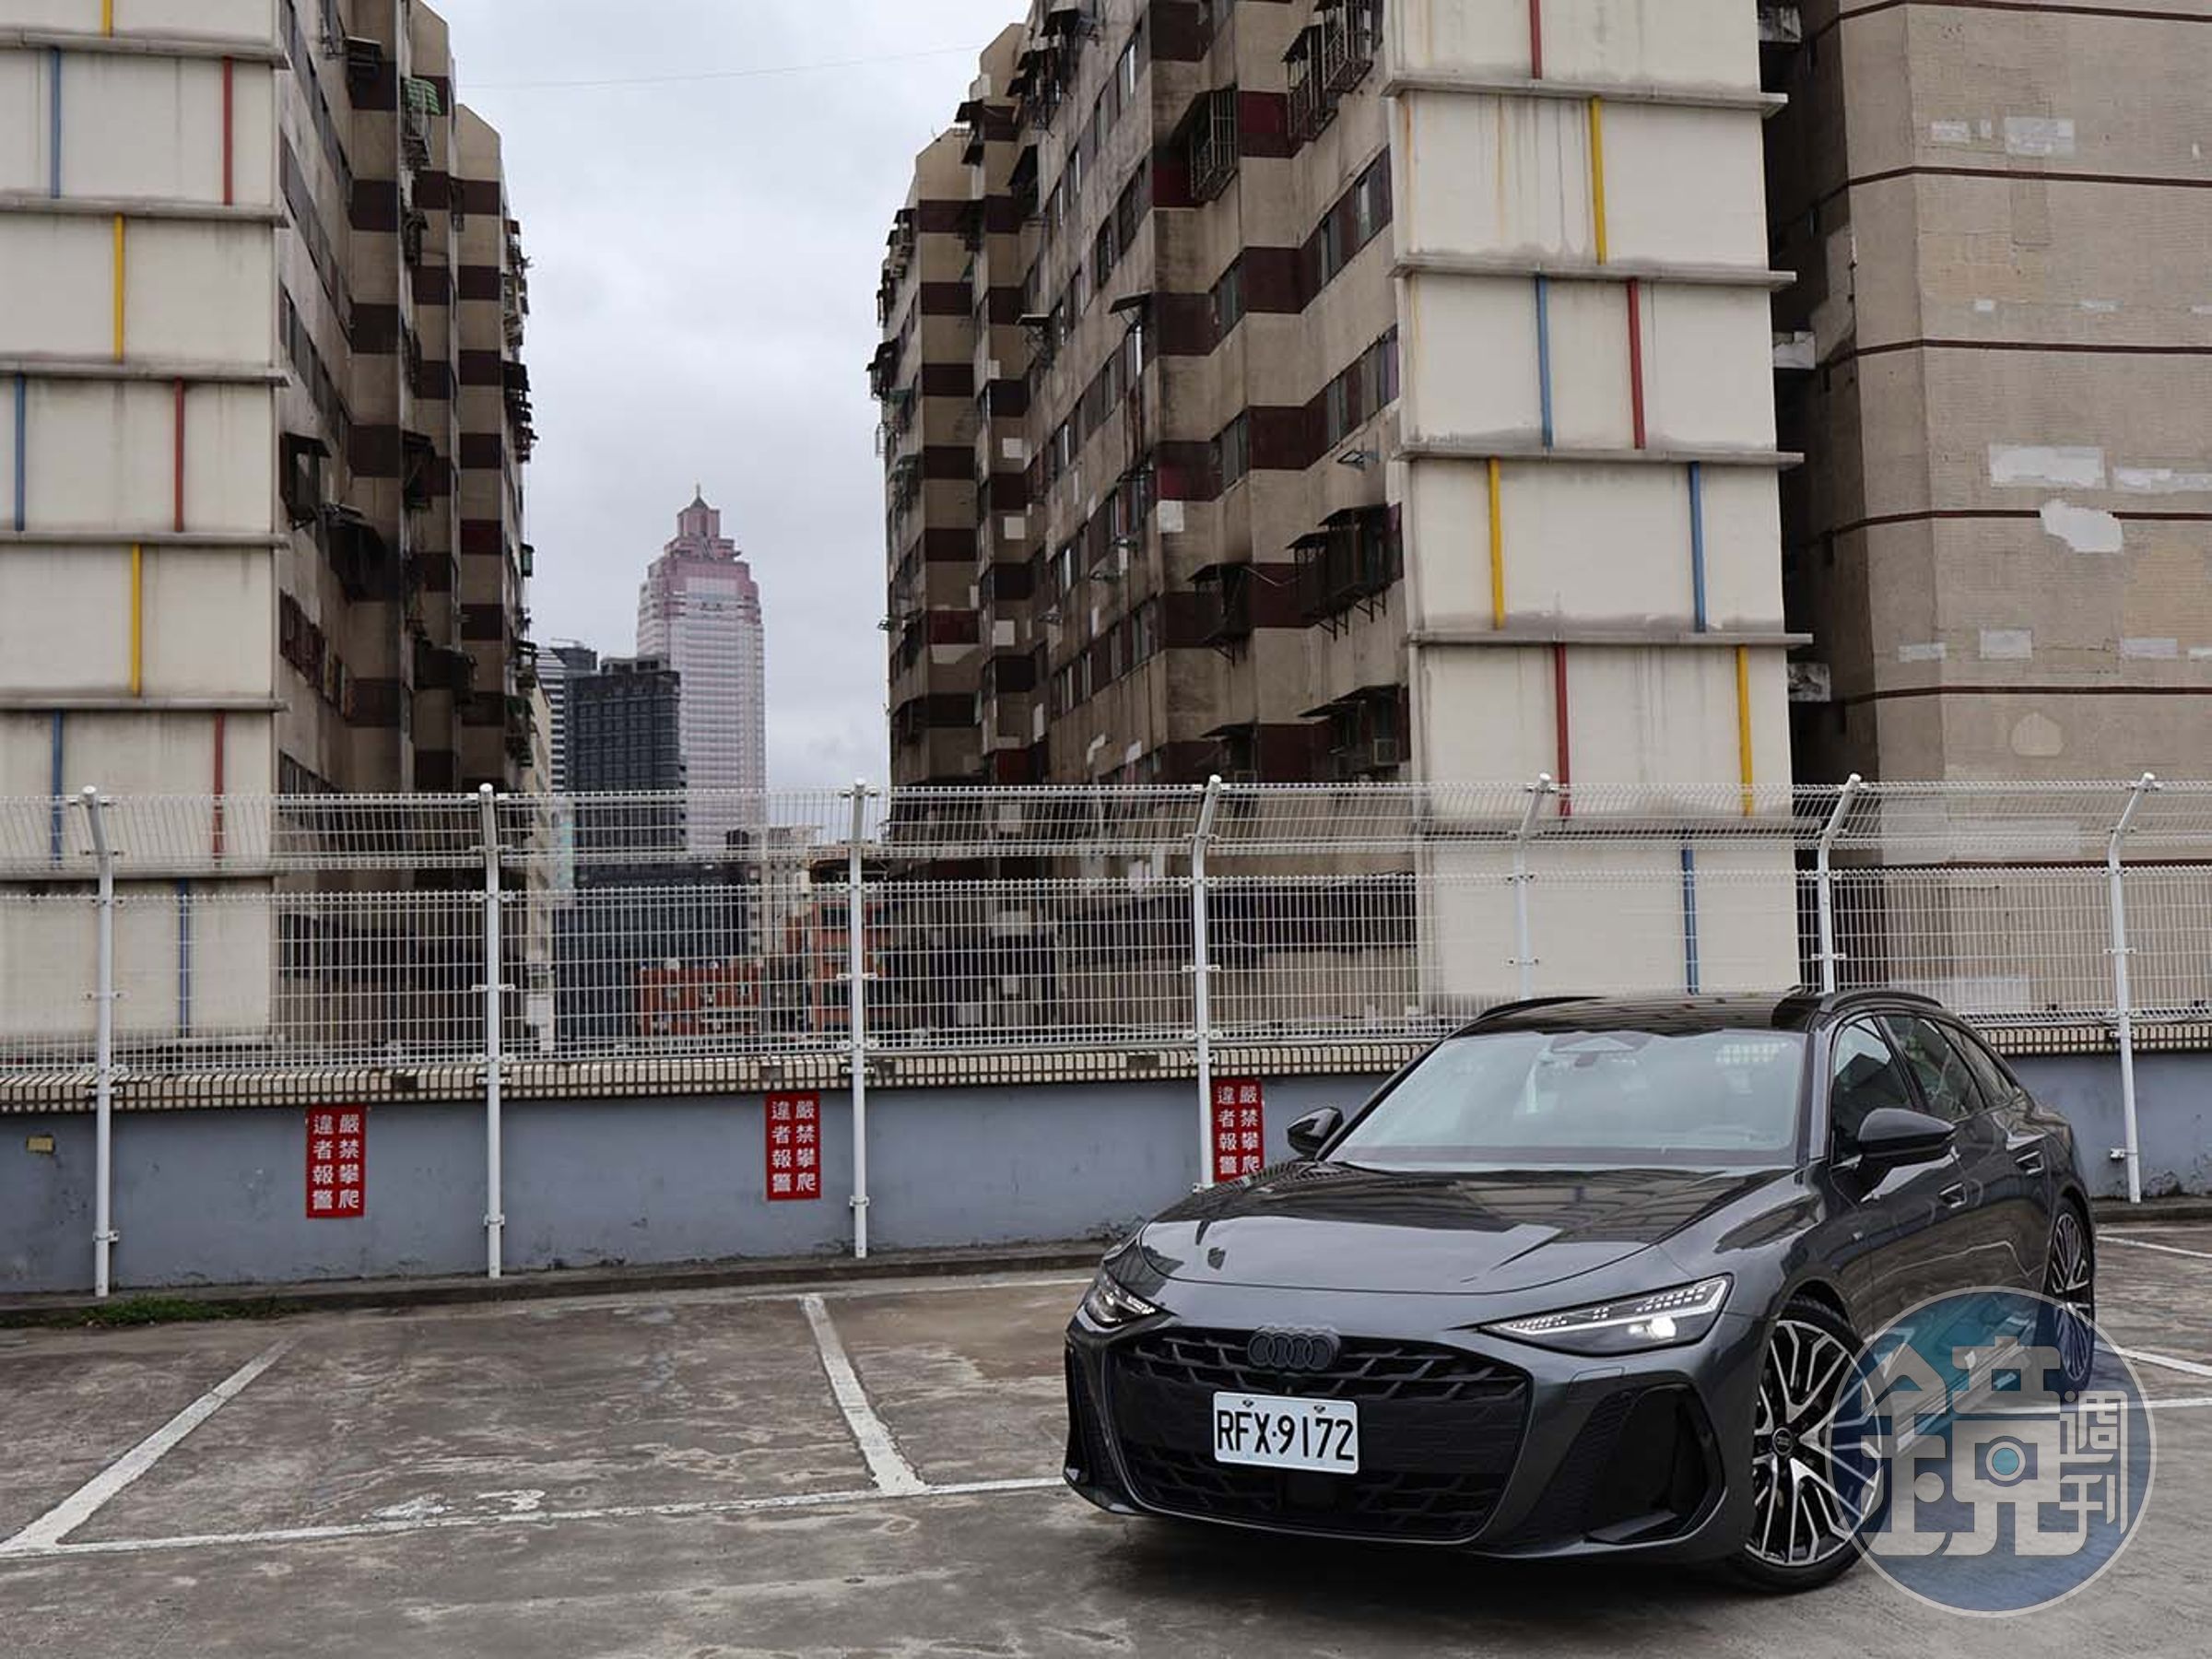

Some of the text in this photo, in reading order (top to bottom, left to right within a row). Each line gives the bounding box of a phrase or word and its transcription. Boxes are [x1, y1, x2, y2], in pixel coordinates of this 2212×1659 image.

[312, 1114, 334, 1210] 違者報警
[337, 1114, 359, 1209] 嚴禁攀爬
[771, 1100, 792, 1193] 違者報警
[794, 1100, 817, 1192] 嚴禁攀爬
[1217, 1086, 1237, 1174] 違者報警
[1239, 1086, 1261, 1173] 嚴禁攀爬
